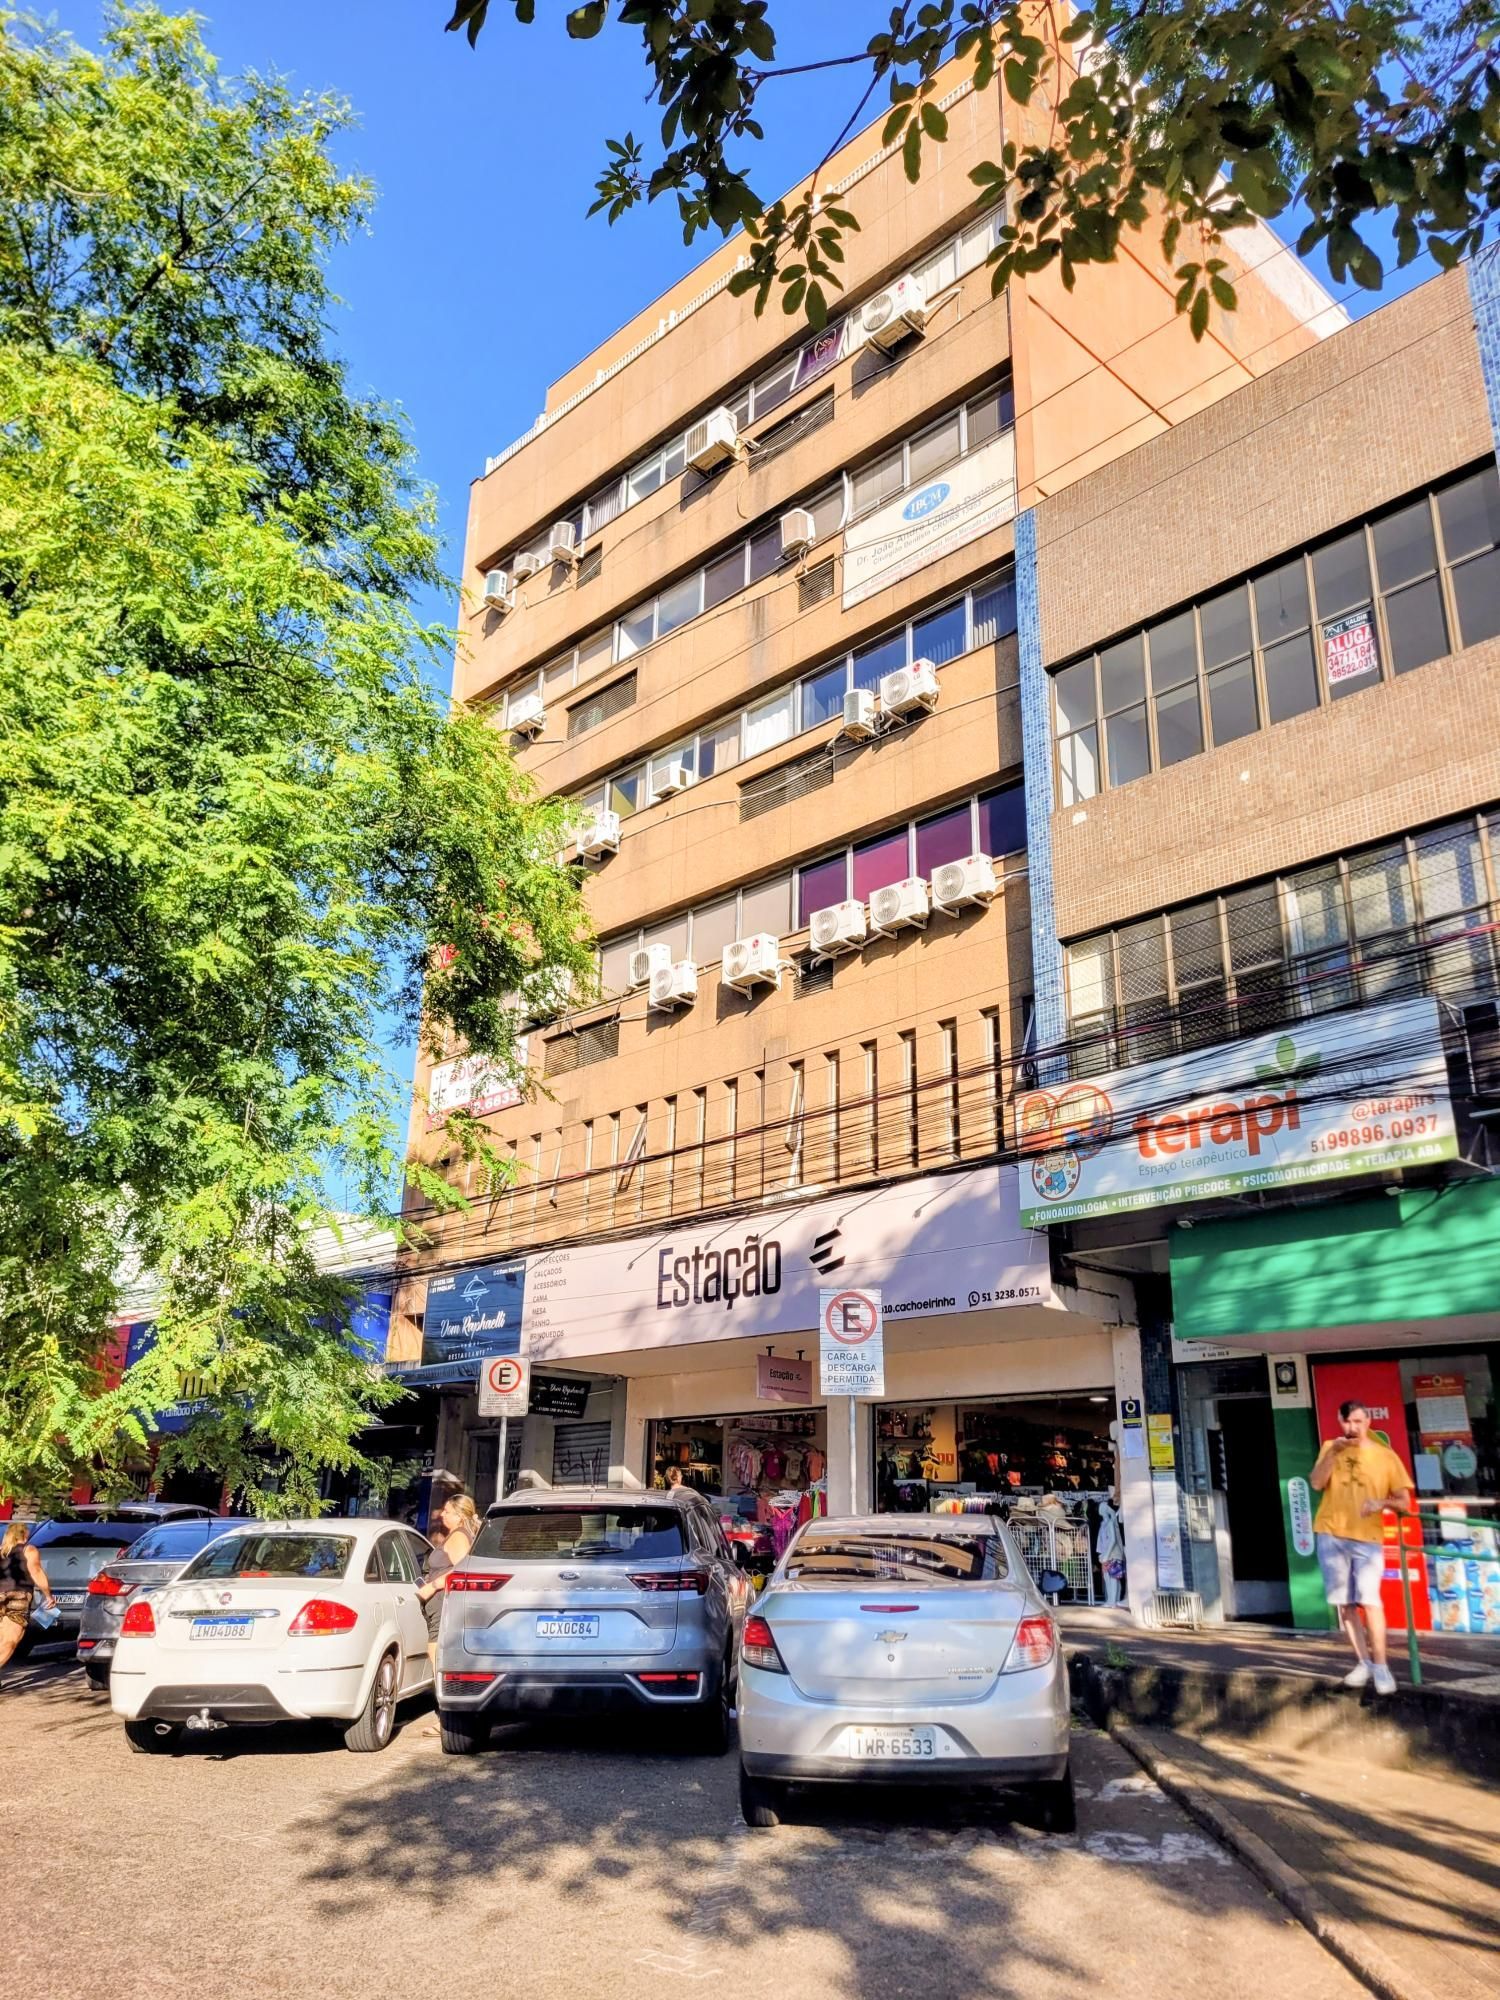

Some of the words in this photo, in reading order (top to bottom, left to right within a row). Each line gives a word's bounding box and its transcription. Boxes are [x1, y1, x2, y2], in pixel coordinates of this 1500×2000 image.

[1328, 626, 1373, 656] ALUGA
[1352, 1091, 1436, 1121] @terapirs
[1132, 1088, 1300, 1159] terapi
[1138, 1159, 1177, 1178] Espaço
[1180, 1148, 1248, 1172] terapêutico
[1034, 1200, 1109, 1221] FONOAUDIOLOGIA
[1118, 1186, 1182, 1208] INTERVENÇÃO
[1184, 1179, 1231, 1197] PRECOCE
[1241, 1159, 1351, 1187] PSICOMOTRICIDADE
[1363, 1148, 1415, 1167] TERAPIA
[1417, 1143, 1443, 1159] ABA
[533, 1266, 563, 1279] CALÇADOS
[657, 1233, 782, 1310] Estação
[532, 1278, 567, 1291] ACESSÓRIOS
[532, 1294, 548, 1304] CAMA
[981, 1292, 991, 1303] 51
[994, 1286, 1041, 1301] 3238.0571
[531, 1307, 547, 1316] MESA
[842, 1303, 862, 1333] E
[461, 1310, 507, 1340] Raphaelli
[531, 1319, 551, 1328] BANHO
[529, 1329, 565, 1341] BRINQUEDOS
[827, 1352, 859, 1361] CARGA
[860, 1352, 867, 1361] E
[827, 1363, 877, 1372] DESCARGA
[498, 1367, 512, 1385] E
[827, 1375, 875, 1384] PERMITIDA
[195, 1624, 246, 1638] IWD4D88
